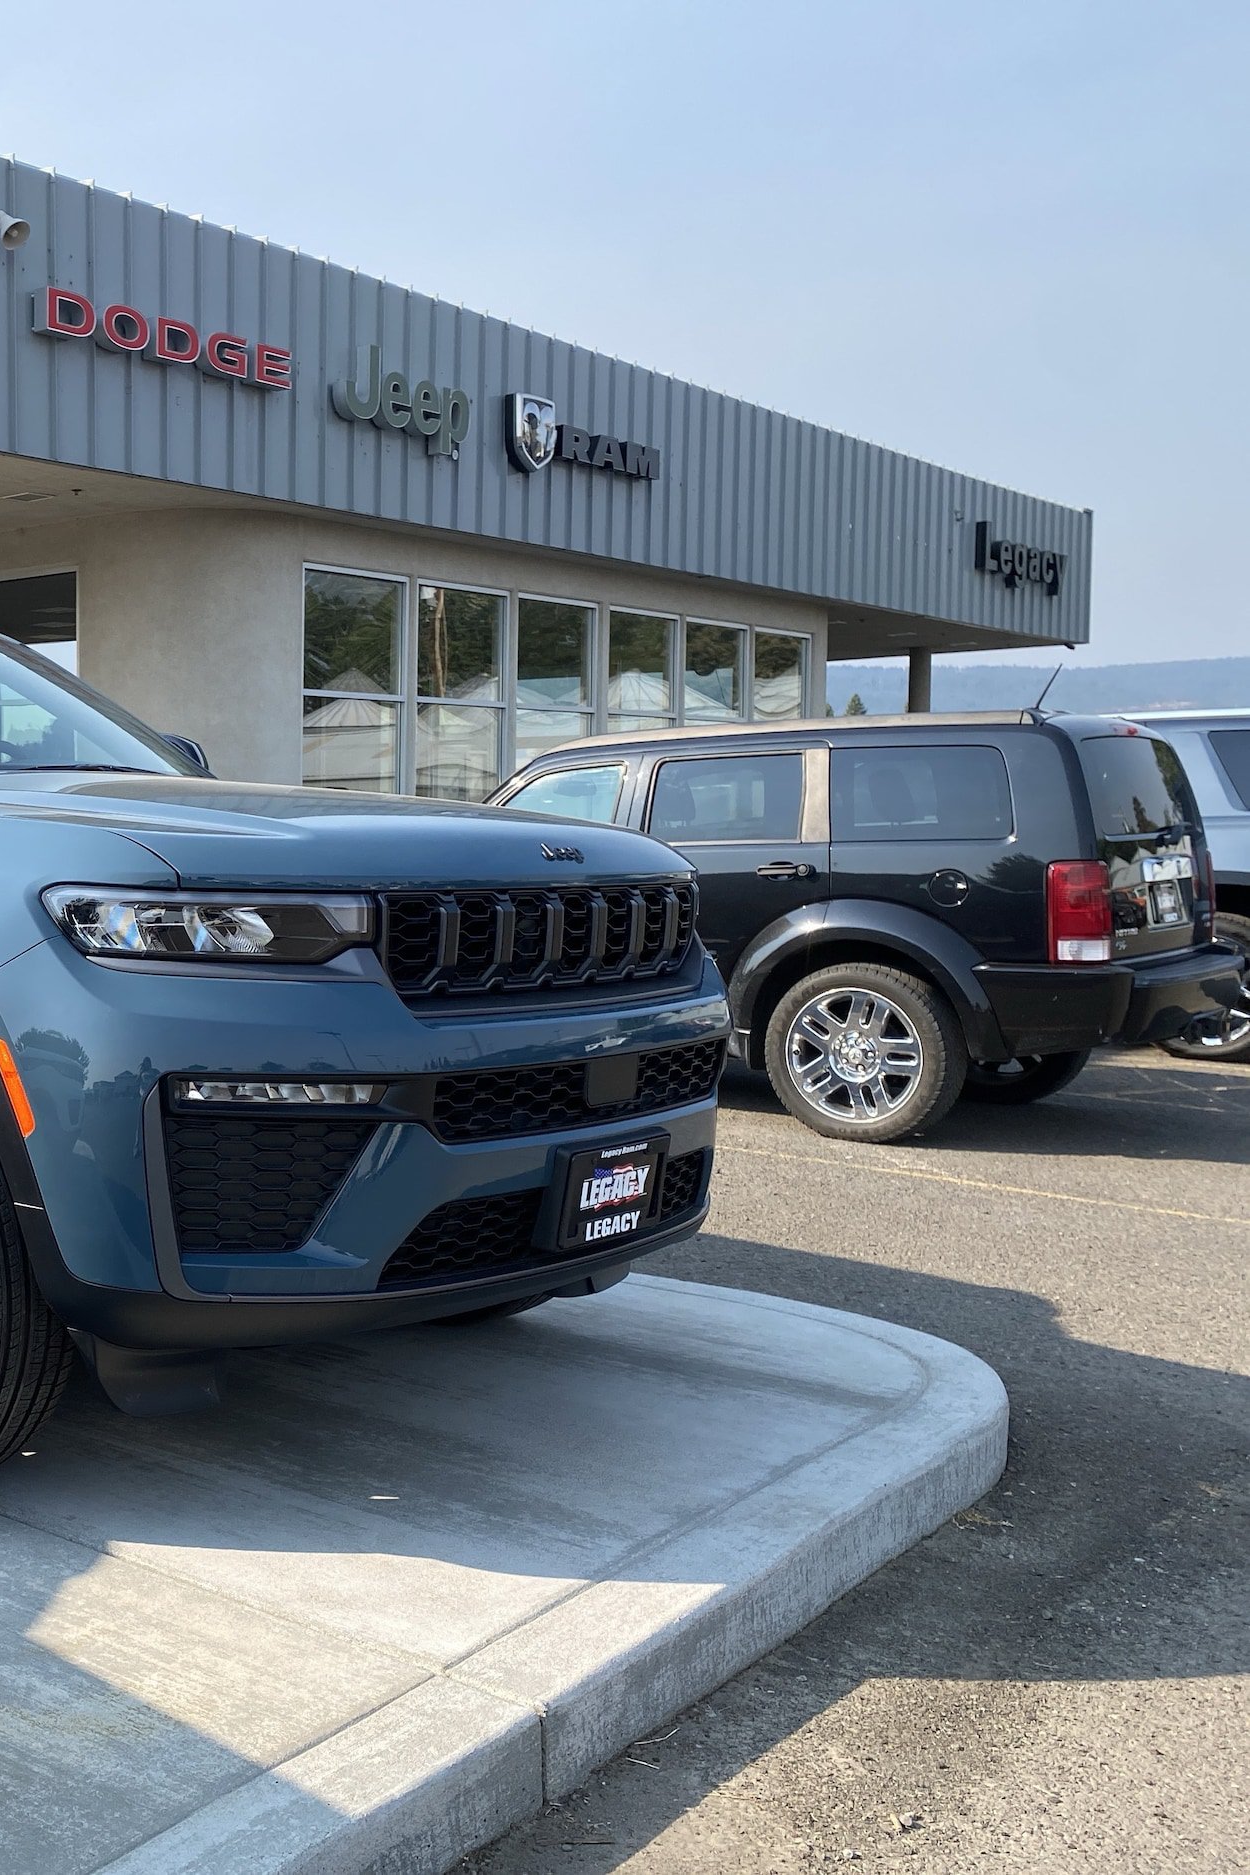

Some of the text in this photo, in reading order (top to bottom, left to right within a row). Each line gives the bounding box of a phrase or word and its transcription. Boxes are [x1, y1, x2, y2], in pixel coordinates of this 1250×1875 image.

[38, 286, 293, 390] DODGE
[335, 344, 471, 457] Jeep
[558, 424, 661, 480] RAM
[976, 521, 1068, 597] Legacy
[540, 843, 585, 864] Jeep
[579, 1166, 650, 1209] LEGACY
[585, 1210, 641, 1242] LEGACY
